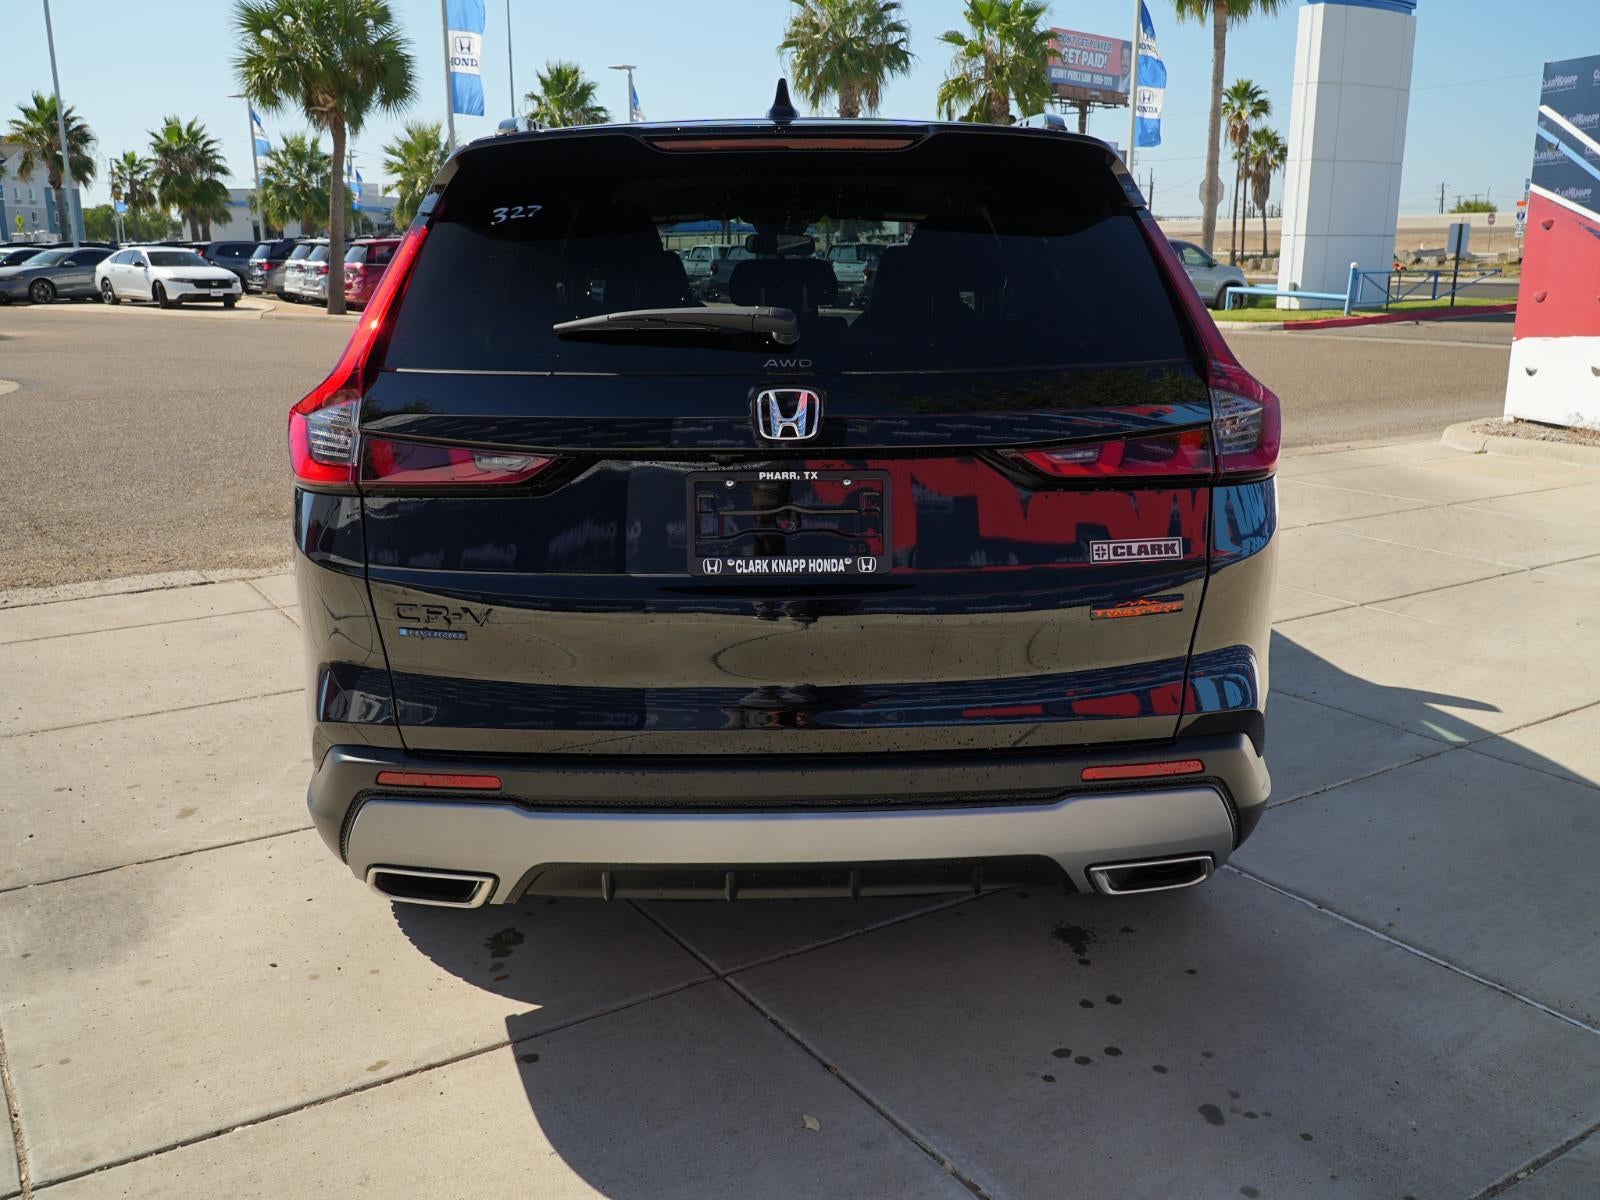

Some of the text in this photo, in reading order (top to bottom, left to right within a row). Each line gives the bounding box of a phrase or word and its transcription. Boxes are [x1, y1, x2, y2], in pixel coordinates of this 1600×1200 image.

[449, 57, 479, 67] HOND
[1062, 47, 1108, 69] GET PAID!
[1136, 105, 1158, 113] ONDA
[490, 204, 543, 226] 327
[763, 358, 813, 368] AWD
[758, 471, 819, 481] PHARR, TX
[1111, 543, 1178, 557] CLARK
[735, 559, 768, 574] CLARK
[771, 559, 806, 573] KNAPP
[808, 558, 846, 573] HONDA
[395, 603, 493, 627] CR-V
